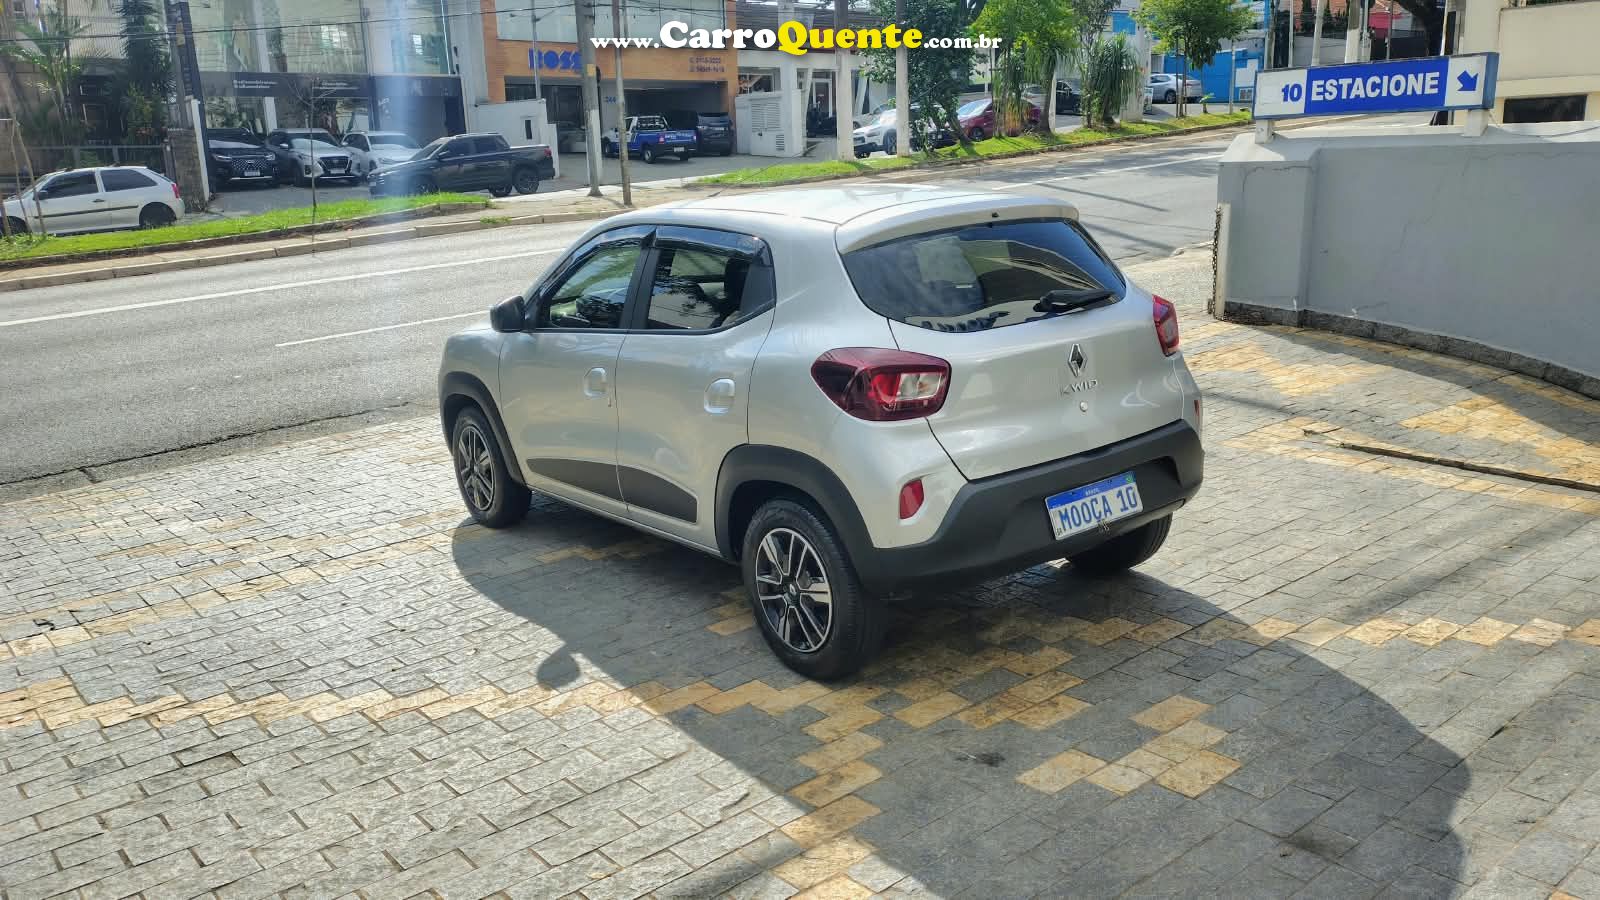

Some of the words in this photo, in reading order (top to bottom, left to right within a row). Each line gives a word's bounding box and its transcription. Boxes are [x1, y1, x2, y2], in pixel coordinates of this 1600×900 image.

[1281, 83, 1304, 102] 10
[1311, 72, 1440, 101] ESTACIONE
[1116, 486, 1138, 512] 10
